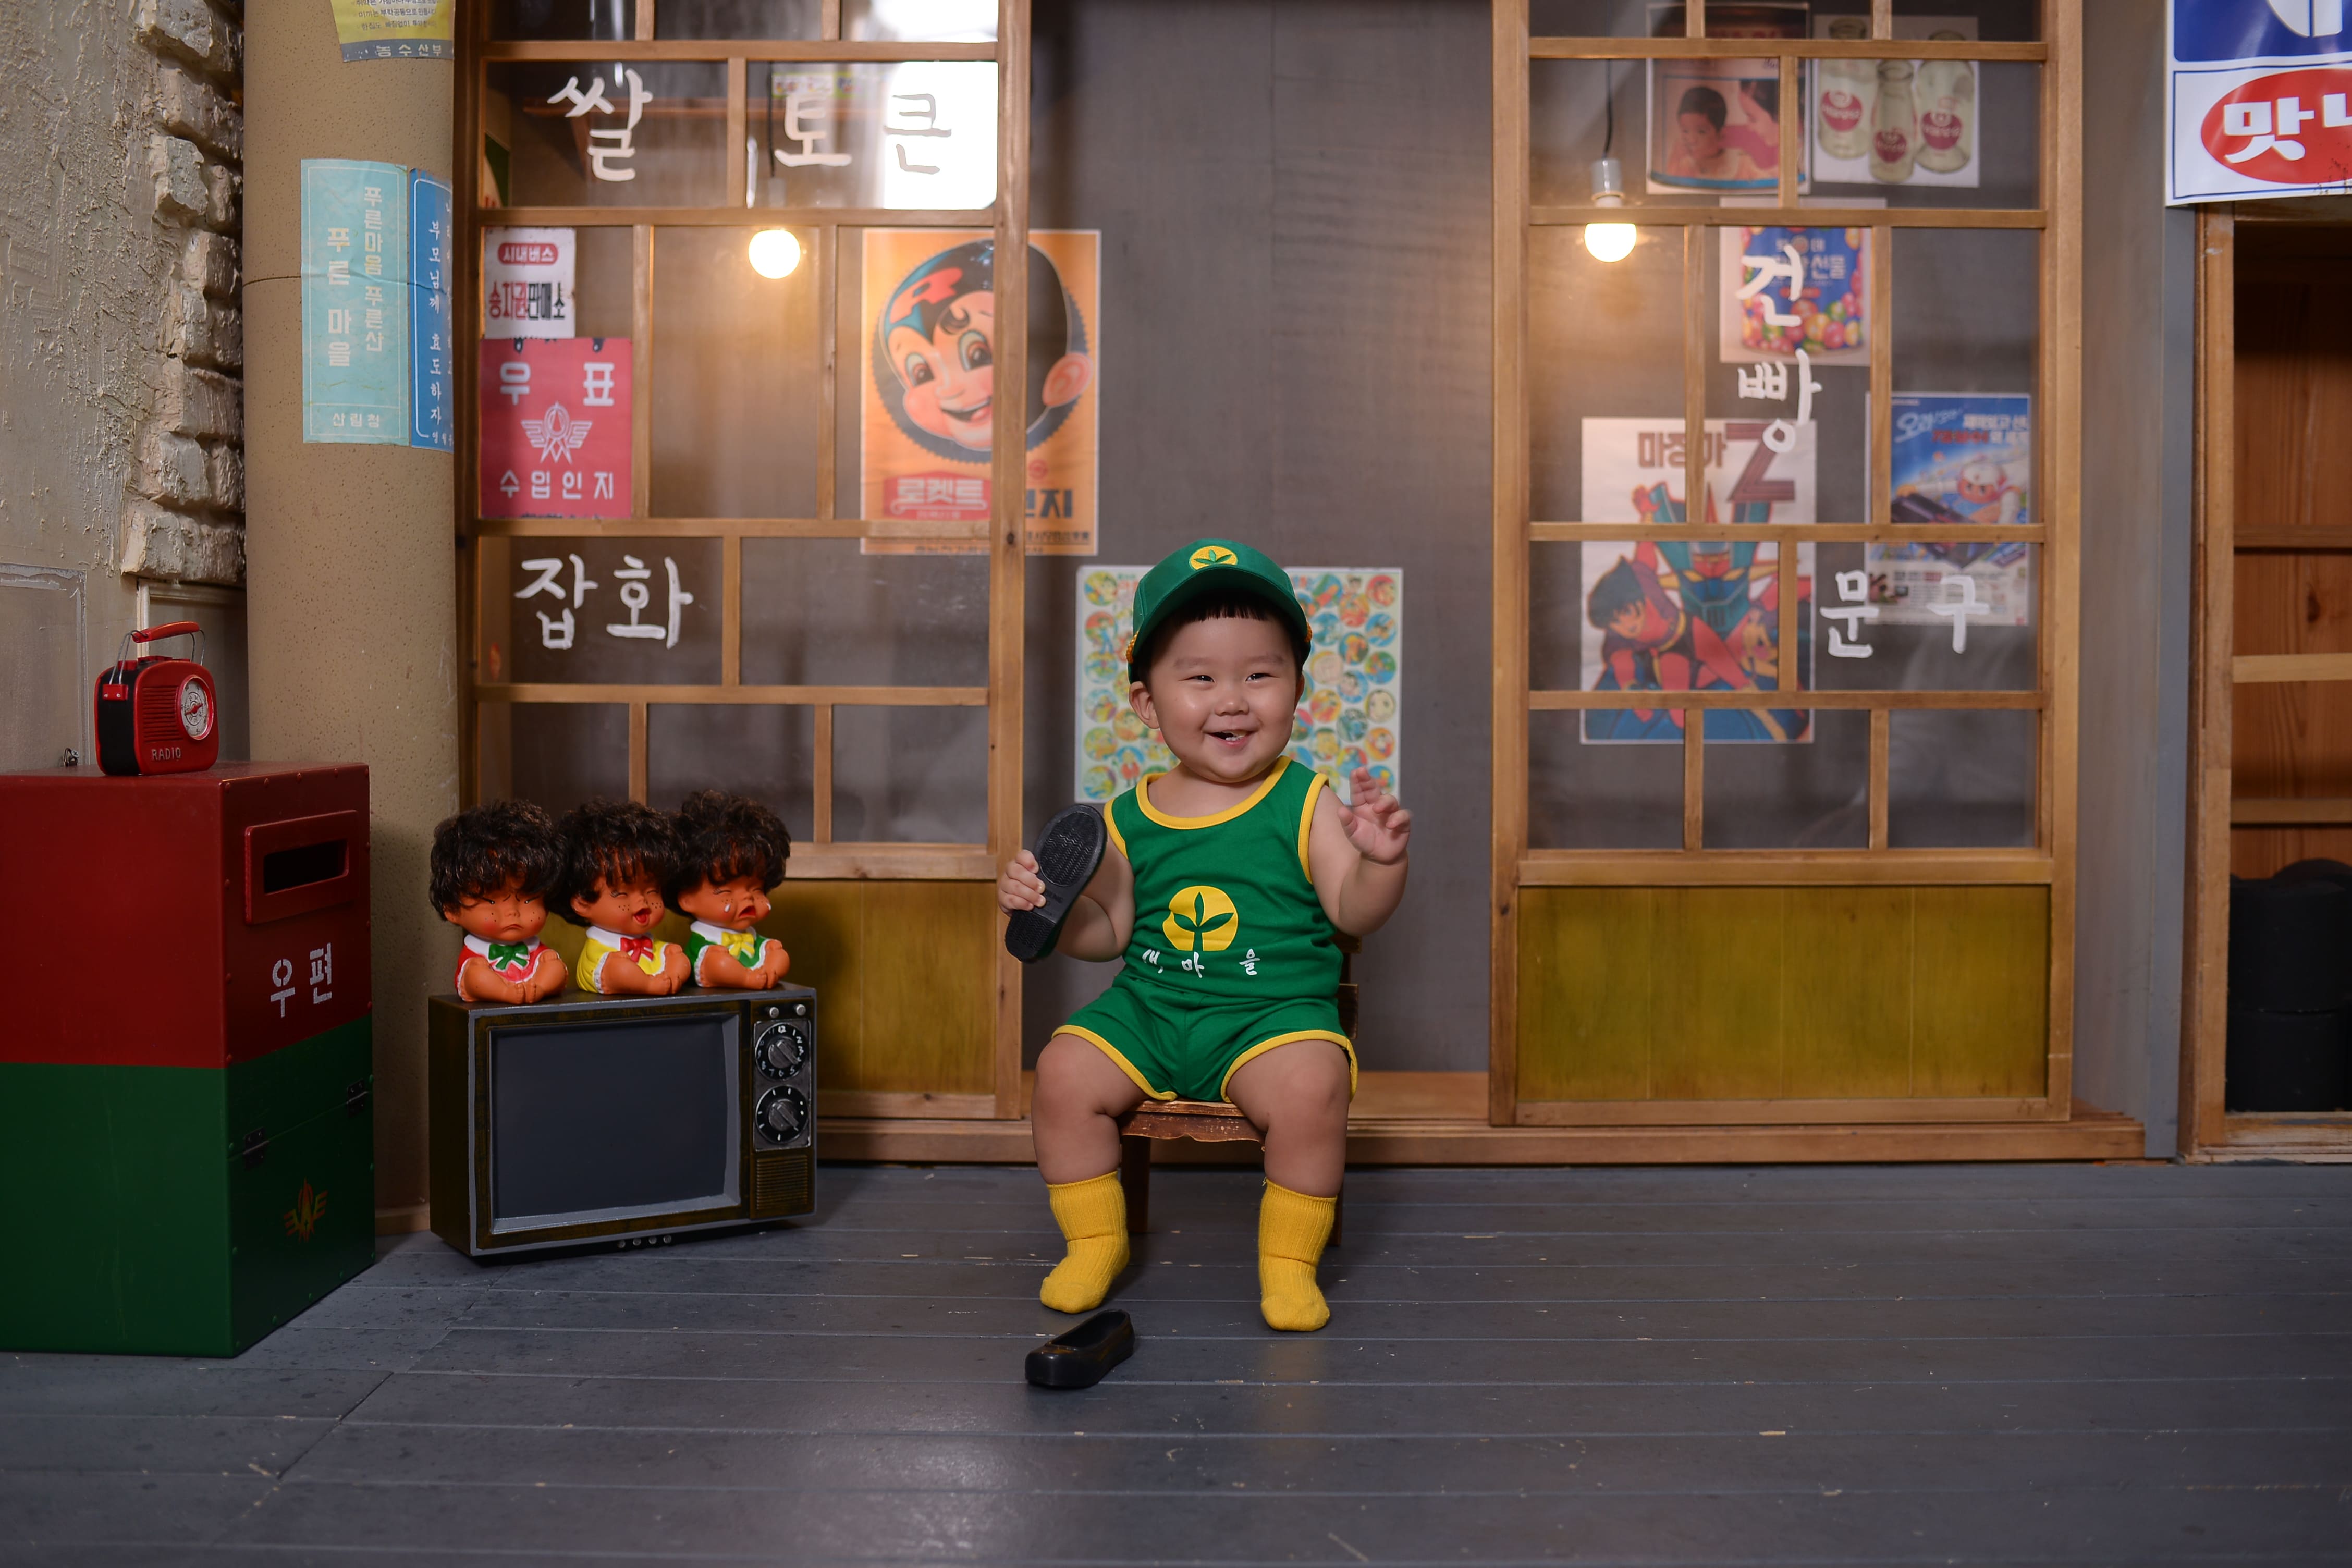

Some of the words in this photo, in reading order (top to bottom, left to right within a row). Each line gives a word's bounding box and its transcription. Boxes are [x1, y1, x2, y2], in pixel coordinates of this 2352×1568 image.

[376, 44, 442, 57] 농수산부
[547, 69, 653, 181] 쌀
[775, 93, 952, 175] 토큰
[327, 227, 351, 286] 푸른
[363, 186, 383, 276] 푸른마음
[428, 220, 440, 314] 부모님께
[503, 245, 555, 262] 시내버스
[328, 309, 352, 368] 마을
[364, 285, 383, 353] 푸른산
[1735, 244, 1823, 453] 건빵
[430, 333, 442, 426] 효도하자
[332, 412, 381, 428] 산림청
[500, 470, 615, 500] 수입인지
[1726, 423, 1795, 501] Z
[514, 553, 694, 650] 잡화
[1819, 570, 1990, 659] 문구
[151, 746, 181, 761] RADIO
[271, 942, 333, 1018] 우편
